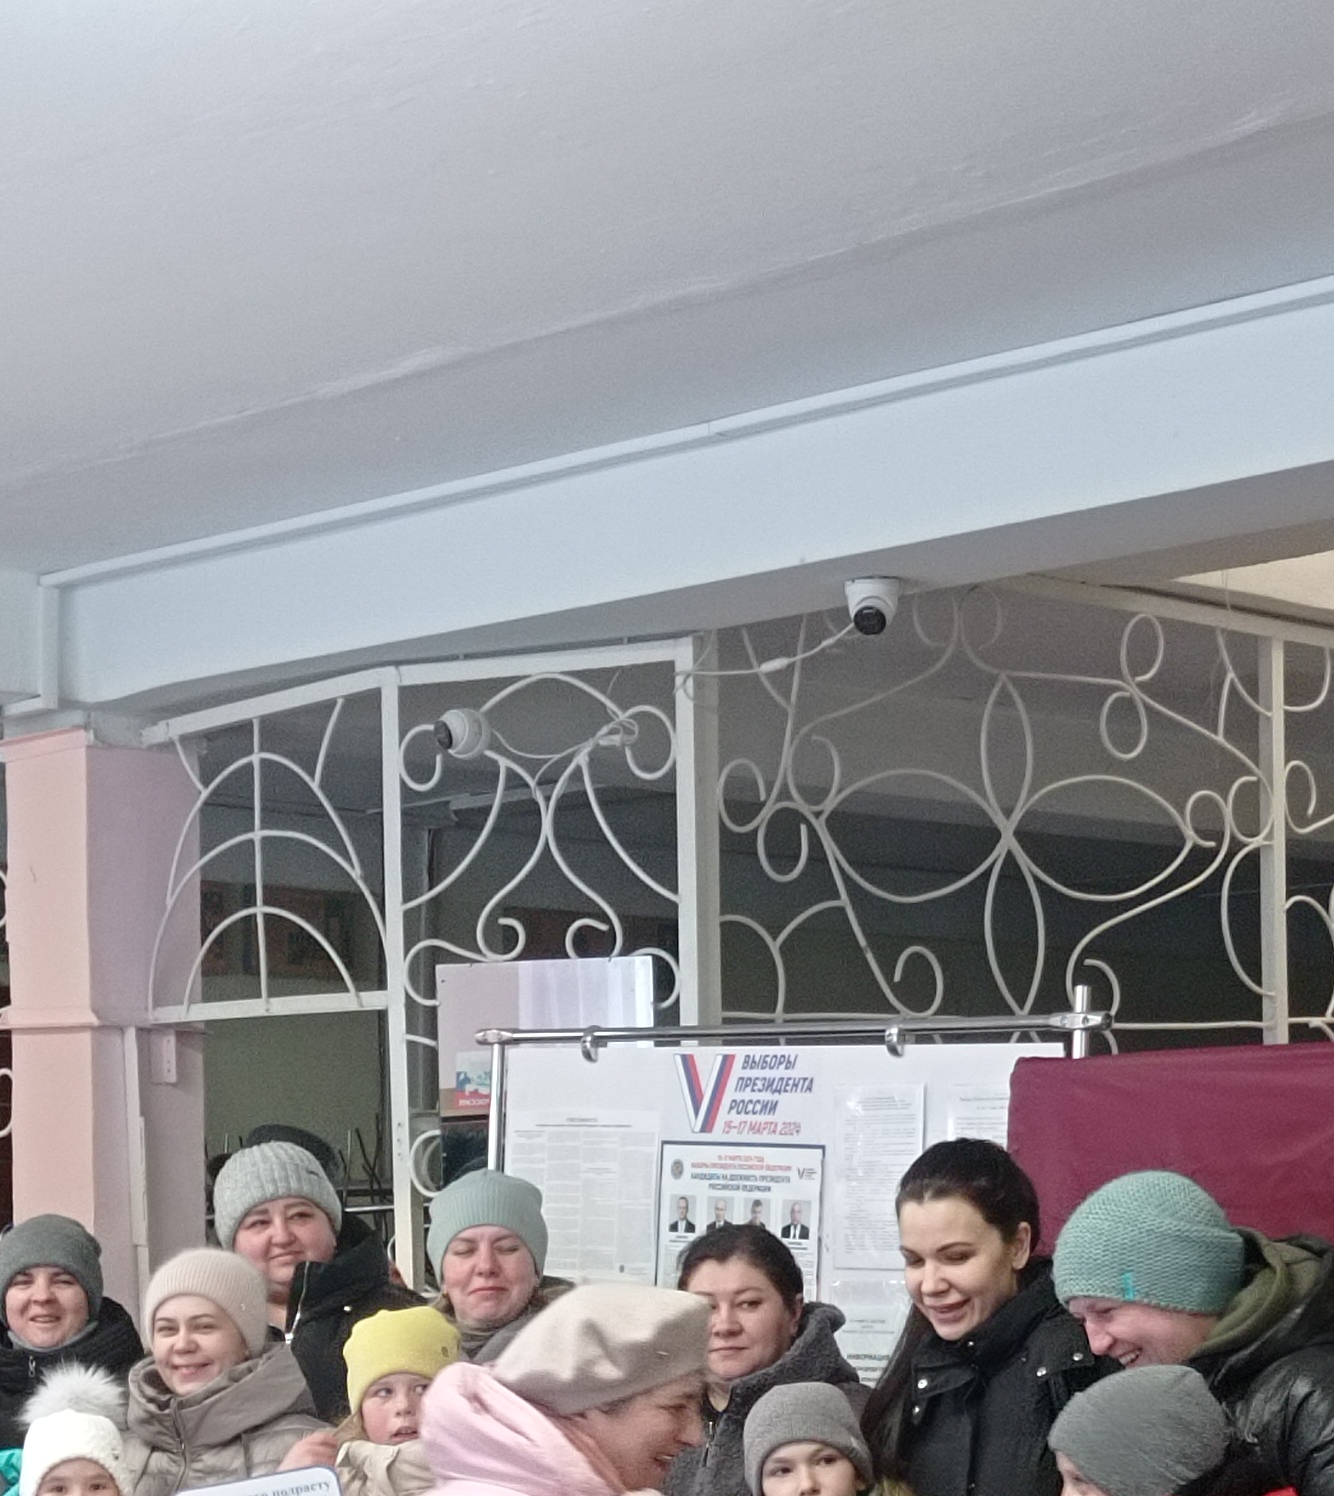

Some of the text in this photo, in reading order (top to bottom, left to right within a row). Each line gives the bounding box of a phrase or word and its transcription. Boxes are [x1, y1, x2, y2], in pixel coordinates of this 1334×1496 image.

[741, 1054, 798, 1070] ВЫБОРЫ
[734, 1077, 814, 1094] ПРЕЗИДЕНТА
[727, 1099, 778, 1115] РОССИИ
[747, 1121, 778, 1135] МАРТА
[779, 1122, 802, 1136] 2024
